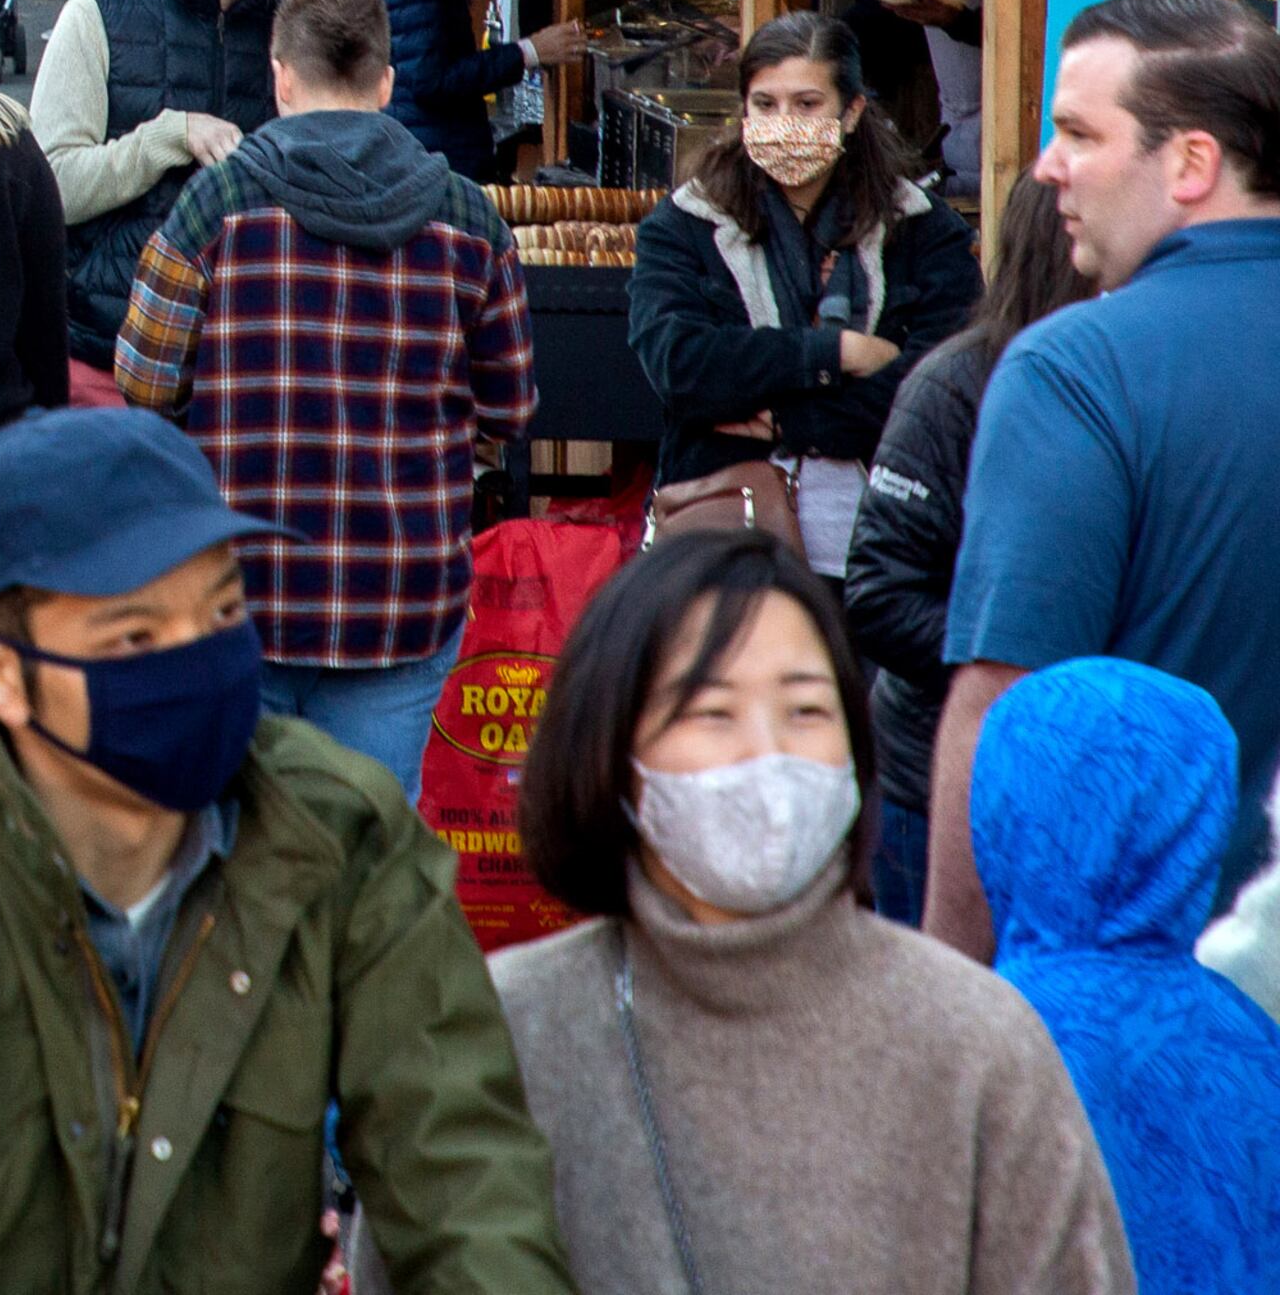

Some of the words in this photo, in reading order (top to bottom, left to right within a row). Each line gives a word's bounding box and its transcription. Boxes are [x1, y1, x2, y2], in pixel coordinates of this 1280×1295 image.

[461, 684, 548, 717] ROYA
[480, 722, 535, 752] OA
[441, 808, 483, 825] 100%
